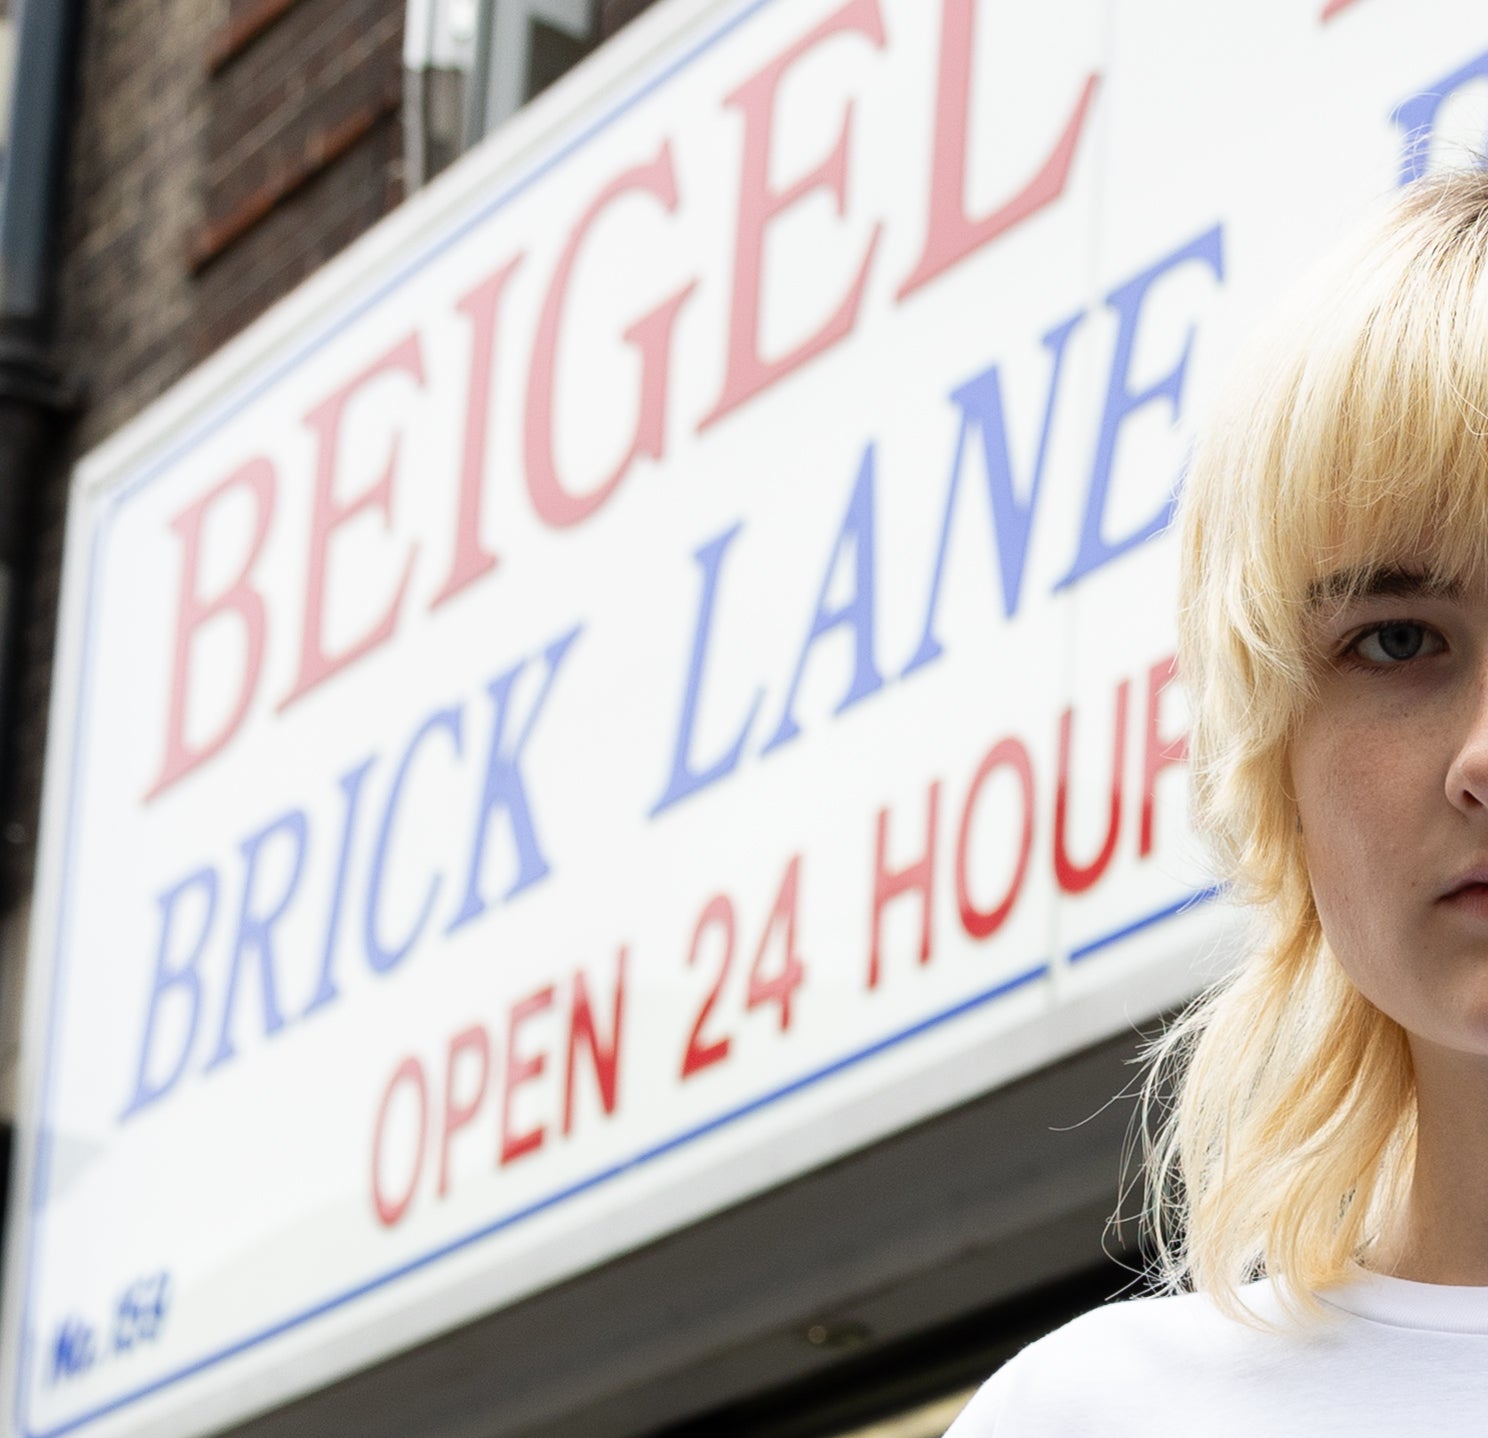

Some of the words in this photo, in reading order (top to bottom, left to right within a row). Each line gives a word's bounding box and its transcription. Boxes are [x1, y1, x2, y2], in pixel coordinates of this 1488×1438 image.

[118, 621, 586, 1125] BRICK
[650, 221, 1227, 817] LANE
[143, 0, 1101, 803] BEIGEL
[368, 943, 632, 1228] OPEN
[680, 851, 808, 1082] 24
